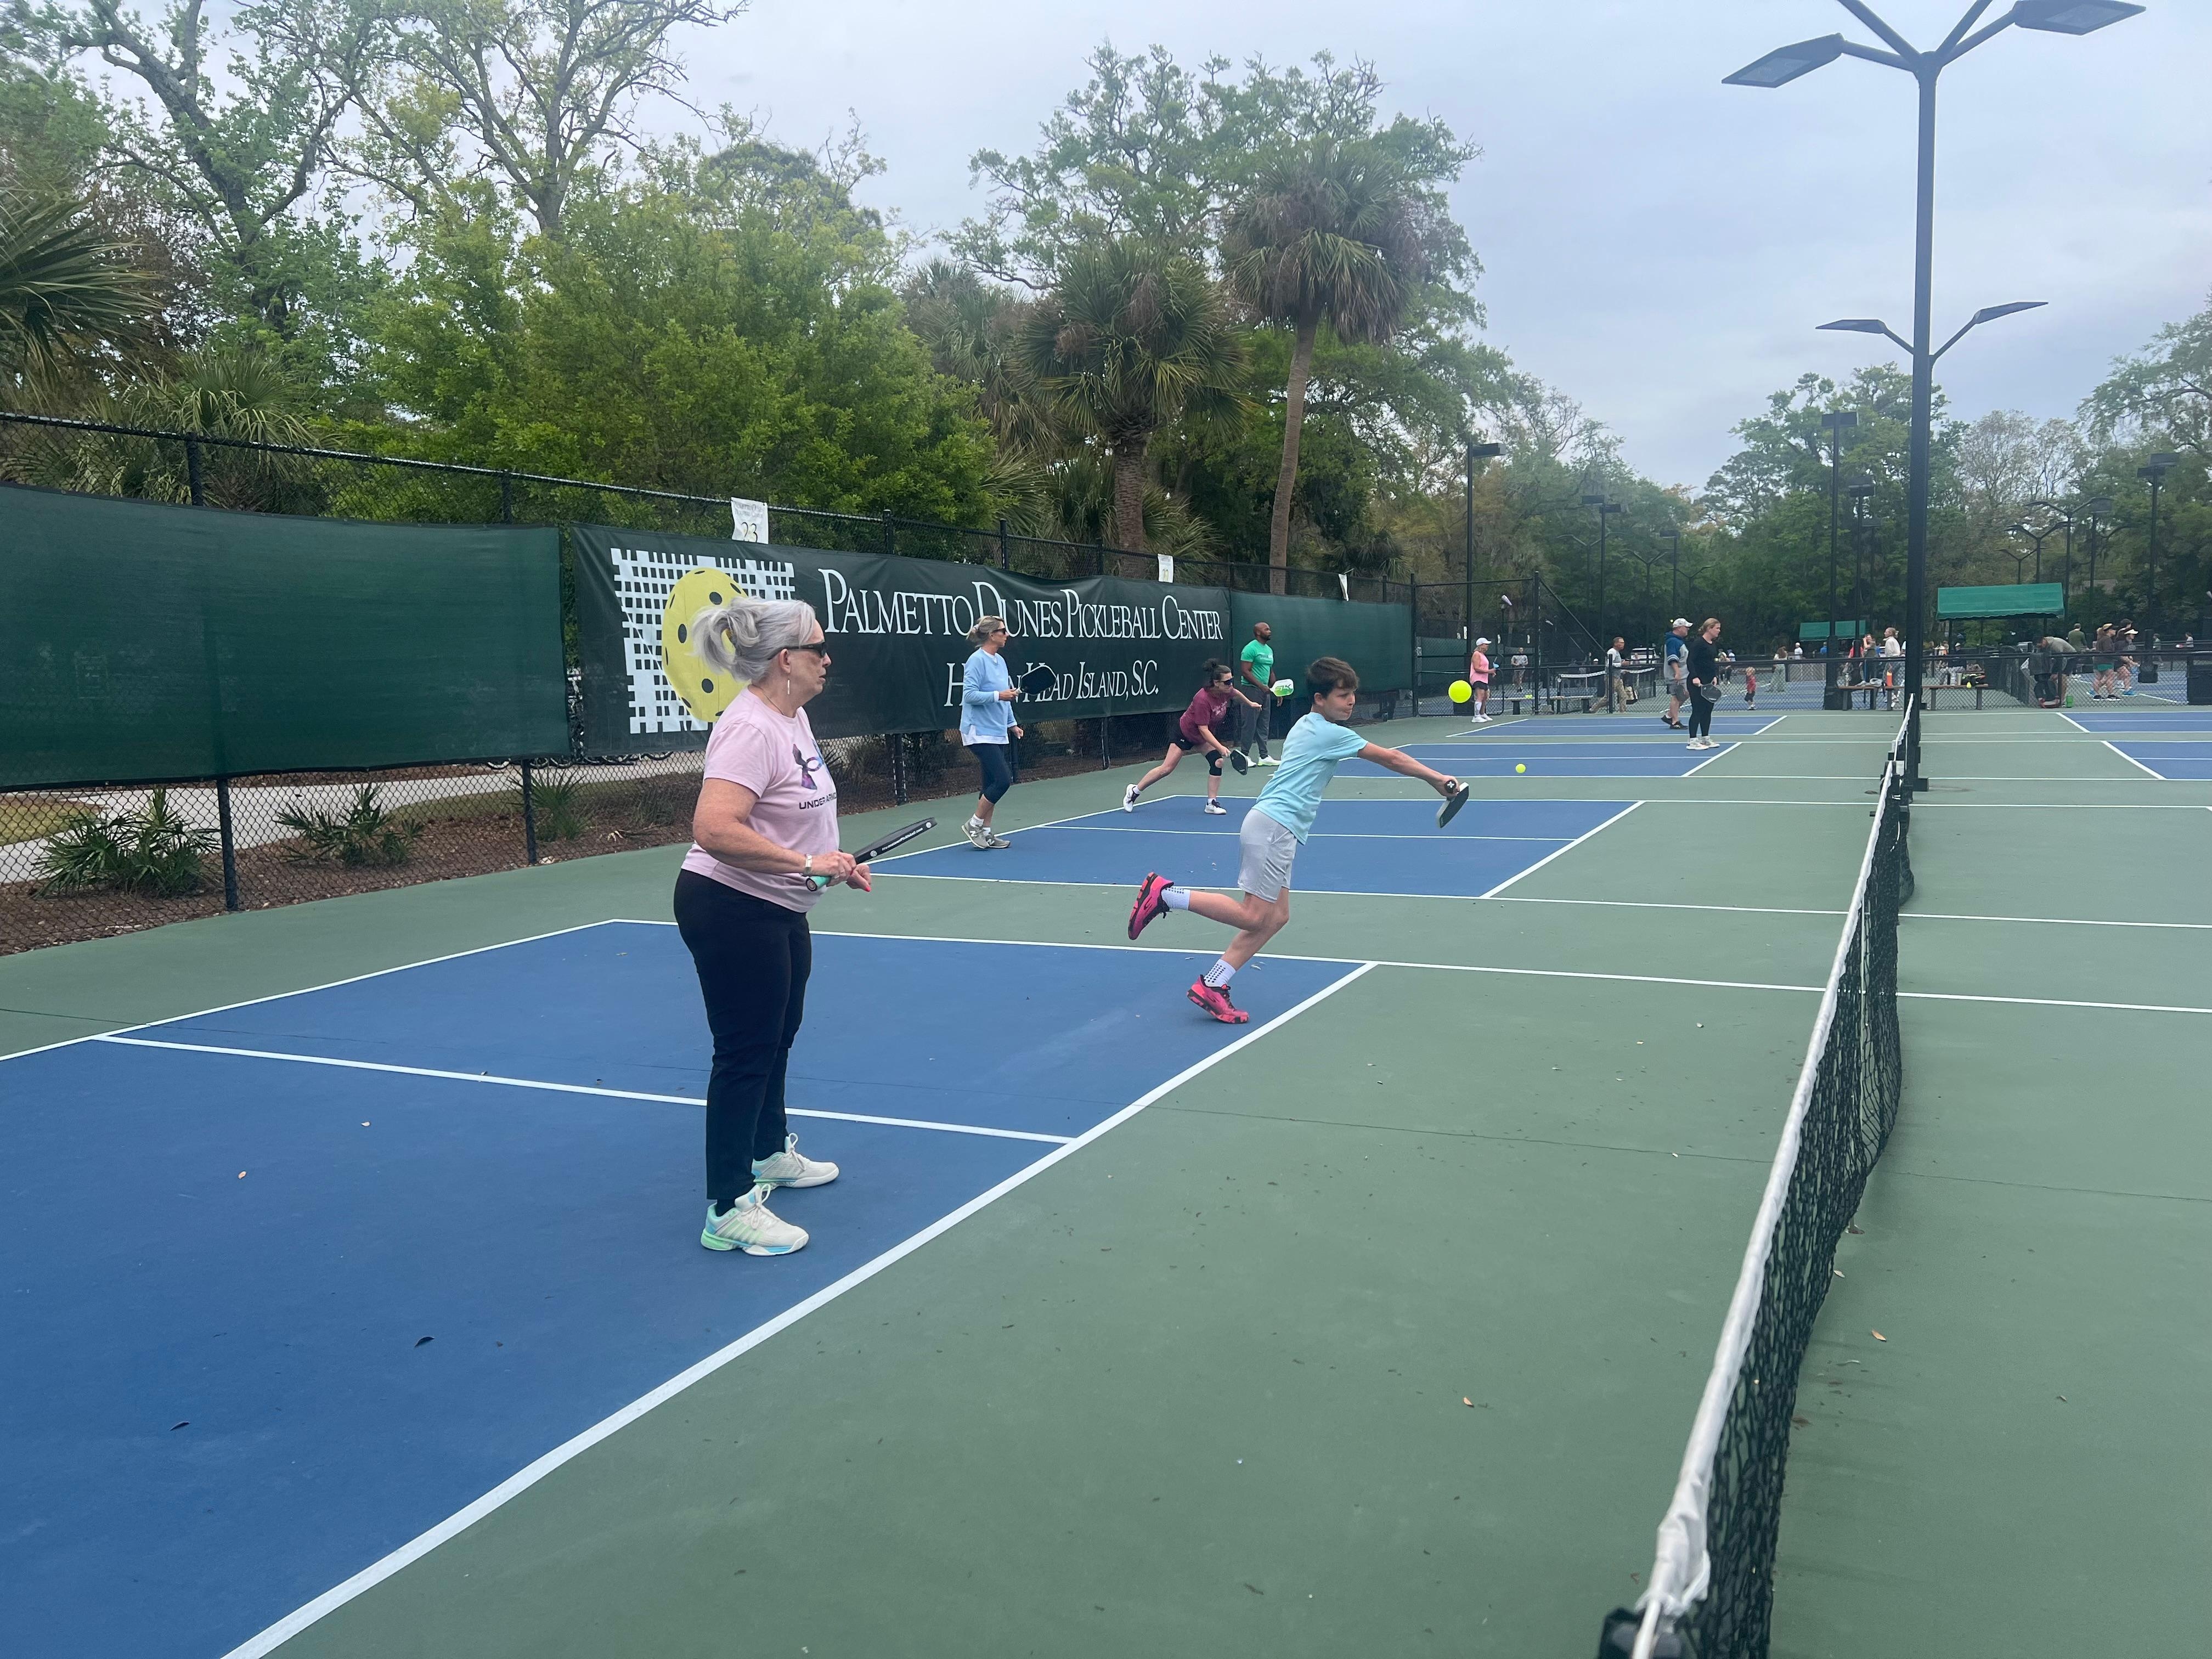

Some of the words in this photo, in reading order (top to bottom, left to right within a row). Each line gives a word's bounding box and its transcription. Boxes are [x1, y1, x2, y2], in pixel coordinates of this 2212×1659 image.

[817, 568, 974, 636] PALMETTO
[972, 582, 1063, 638] DUNES
[1060, 589, 1162, 639] PICKLEBALL
[1162, 595, 1223, 640] CENTER
[1076, 662, 1128, 701] ISLAND,
[1131, 660, 1159, 696] S.C.
